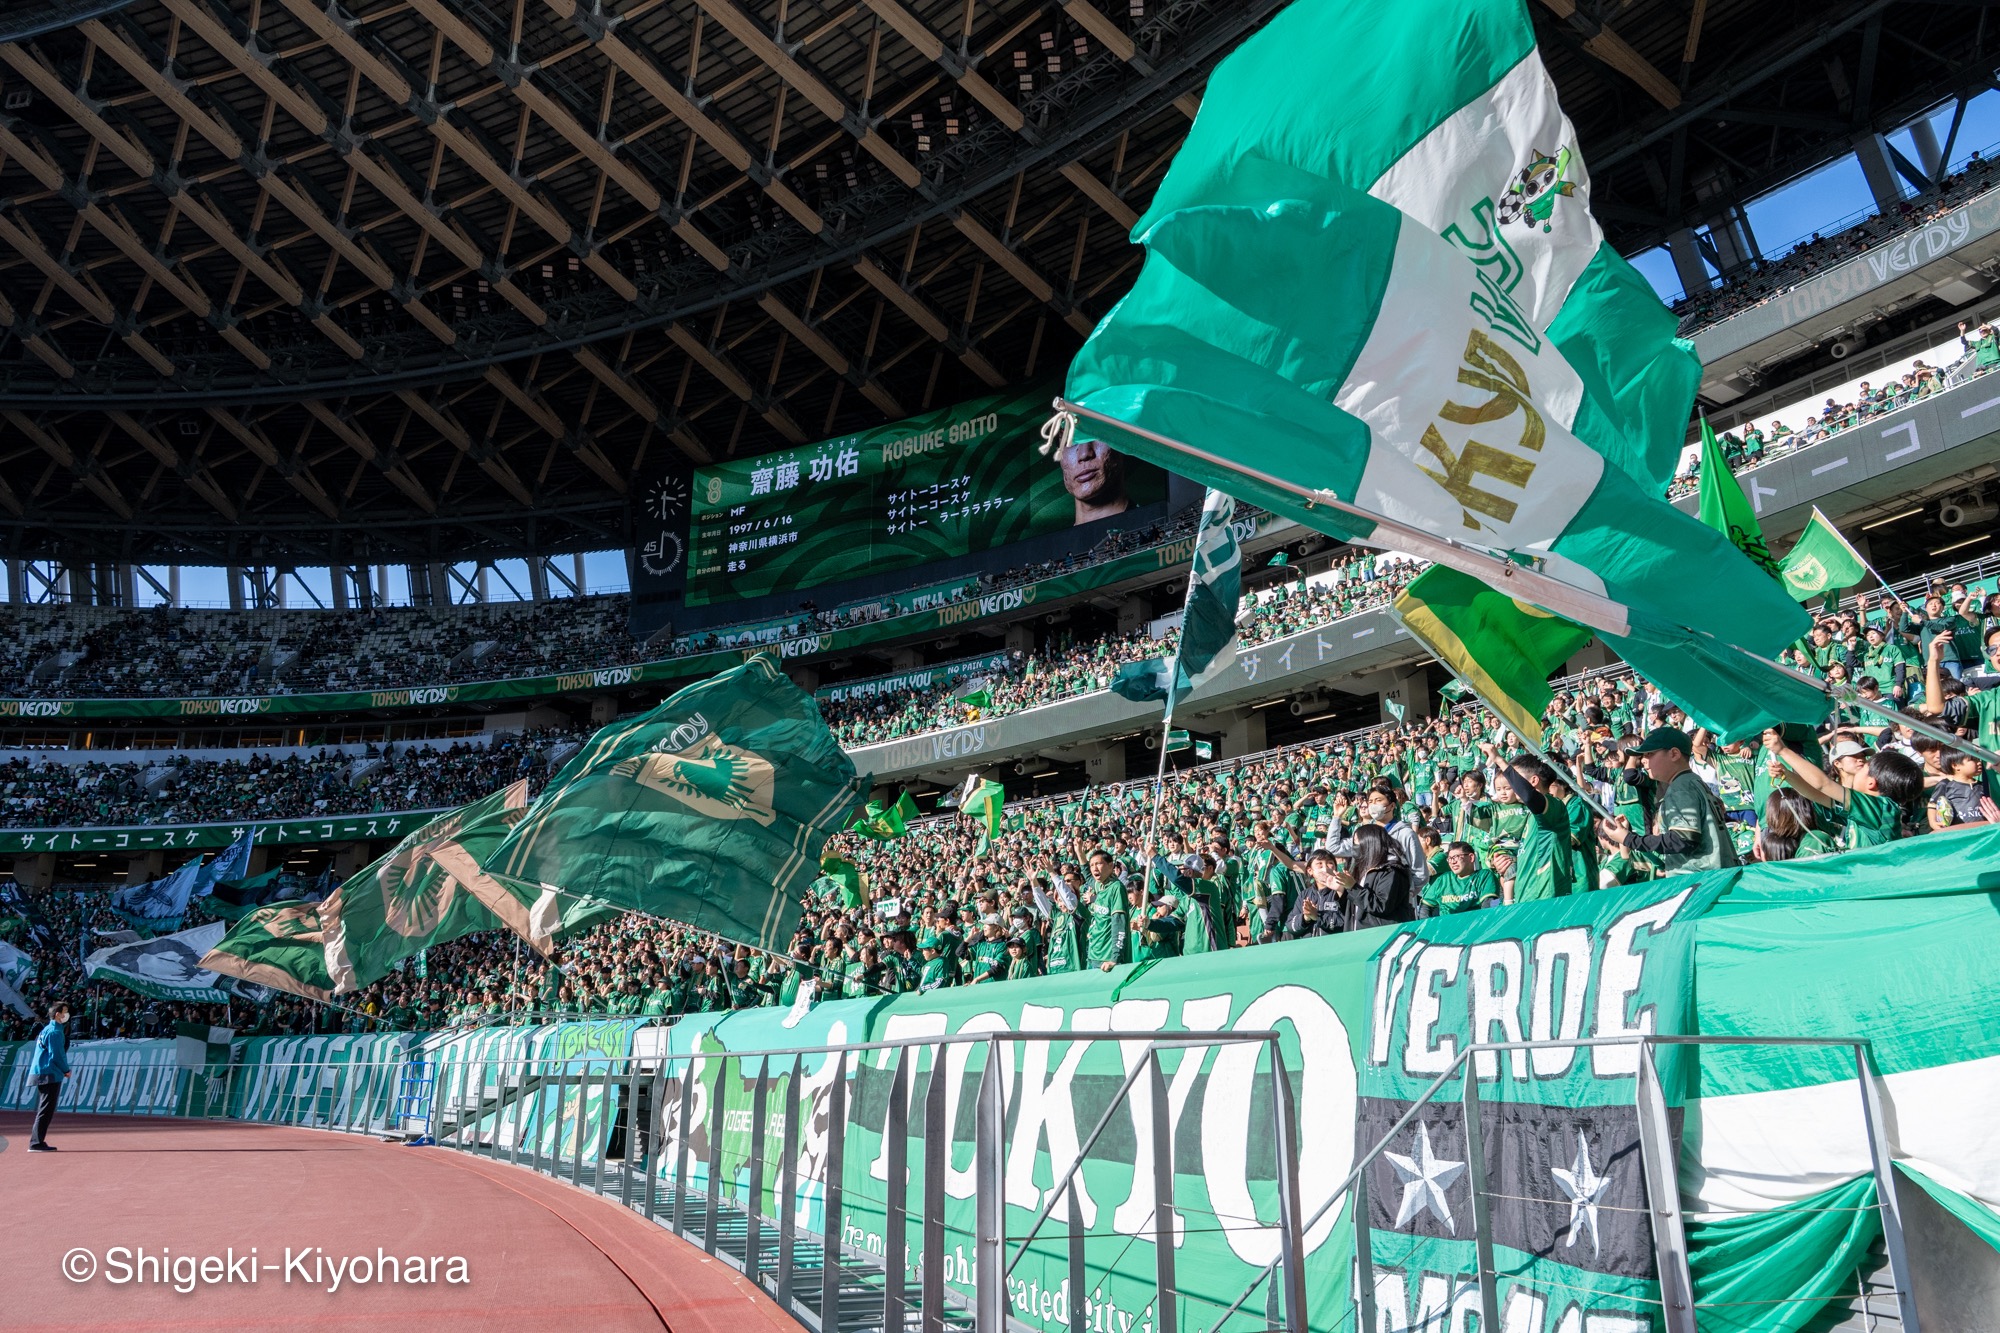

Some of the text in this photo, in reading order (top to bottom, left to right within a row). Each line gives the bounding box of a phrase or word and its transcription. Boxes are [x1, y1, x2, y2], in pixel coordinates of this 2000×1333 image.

[882, 412, 998, 463] KOSUKE SAITO
[755, 437, 858, 467] さいとう こうすけ
[808, 447, 860, 482] 功佑
[707, 476, 723, 504] 8
[887, 475, 971, 505] サイトーコースケ
[730, 506, 746, 517] MF
[886, 497, 1014, 536] サイトー ラーララララー
[887, 491, 971, 520] サイトーコースケ
[729, 522, 753, 535] 1997
[763, 520, 771, 529] 6
[781, 514, 793, 525] 16
[643, 541, 657, 552] 45
[728, 531, 798, 554] 神奈川県横浜市
[727, 560, 747, 573] 走る
[908, 672, 932, 689] YOU
[947, 661, 984, 675] NO PAIN.
[1090, 758, 1102, 767] 141
[21, 830, 200, 850] サイトーコースケ
[231, 817, 401, 843] サイトーコースケ
[1371, 884, 1694, 1081] VERDE
[869, 984, 1358, 1268] TOKYO
